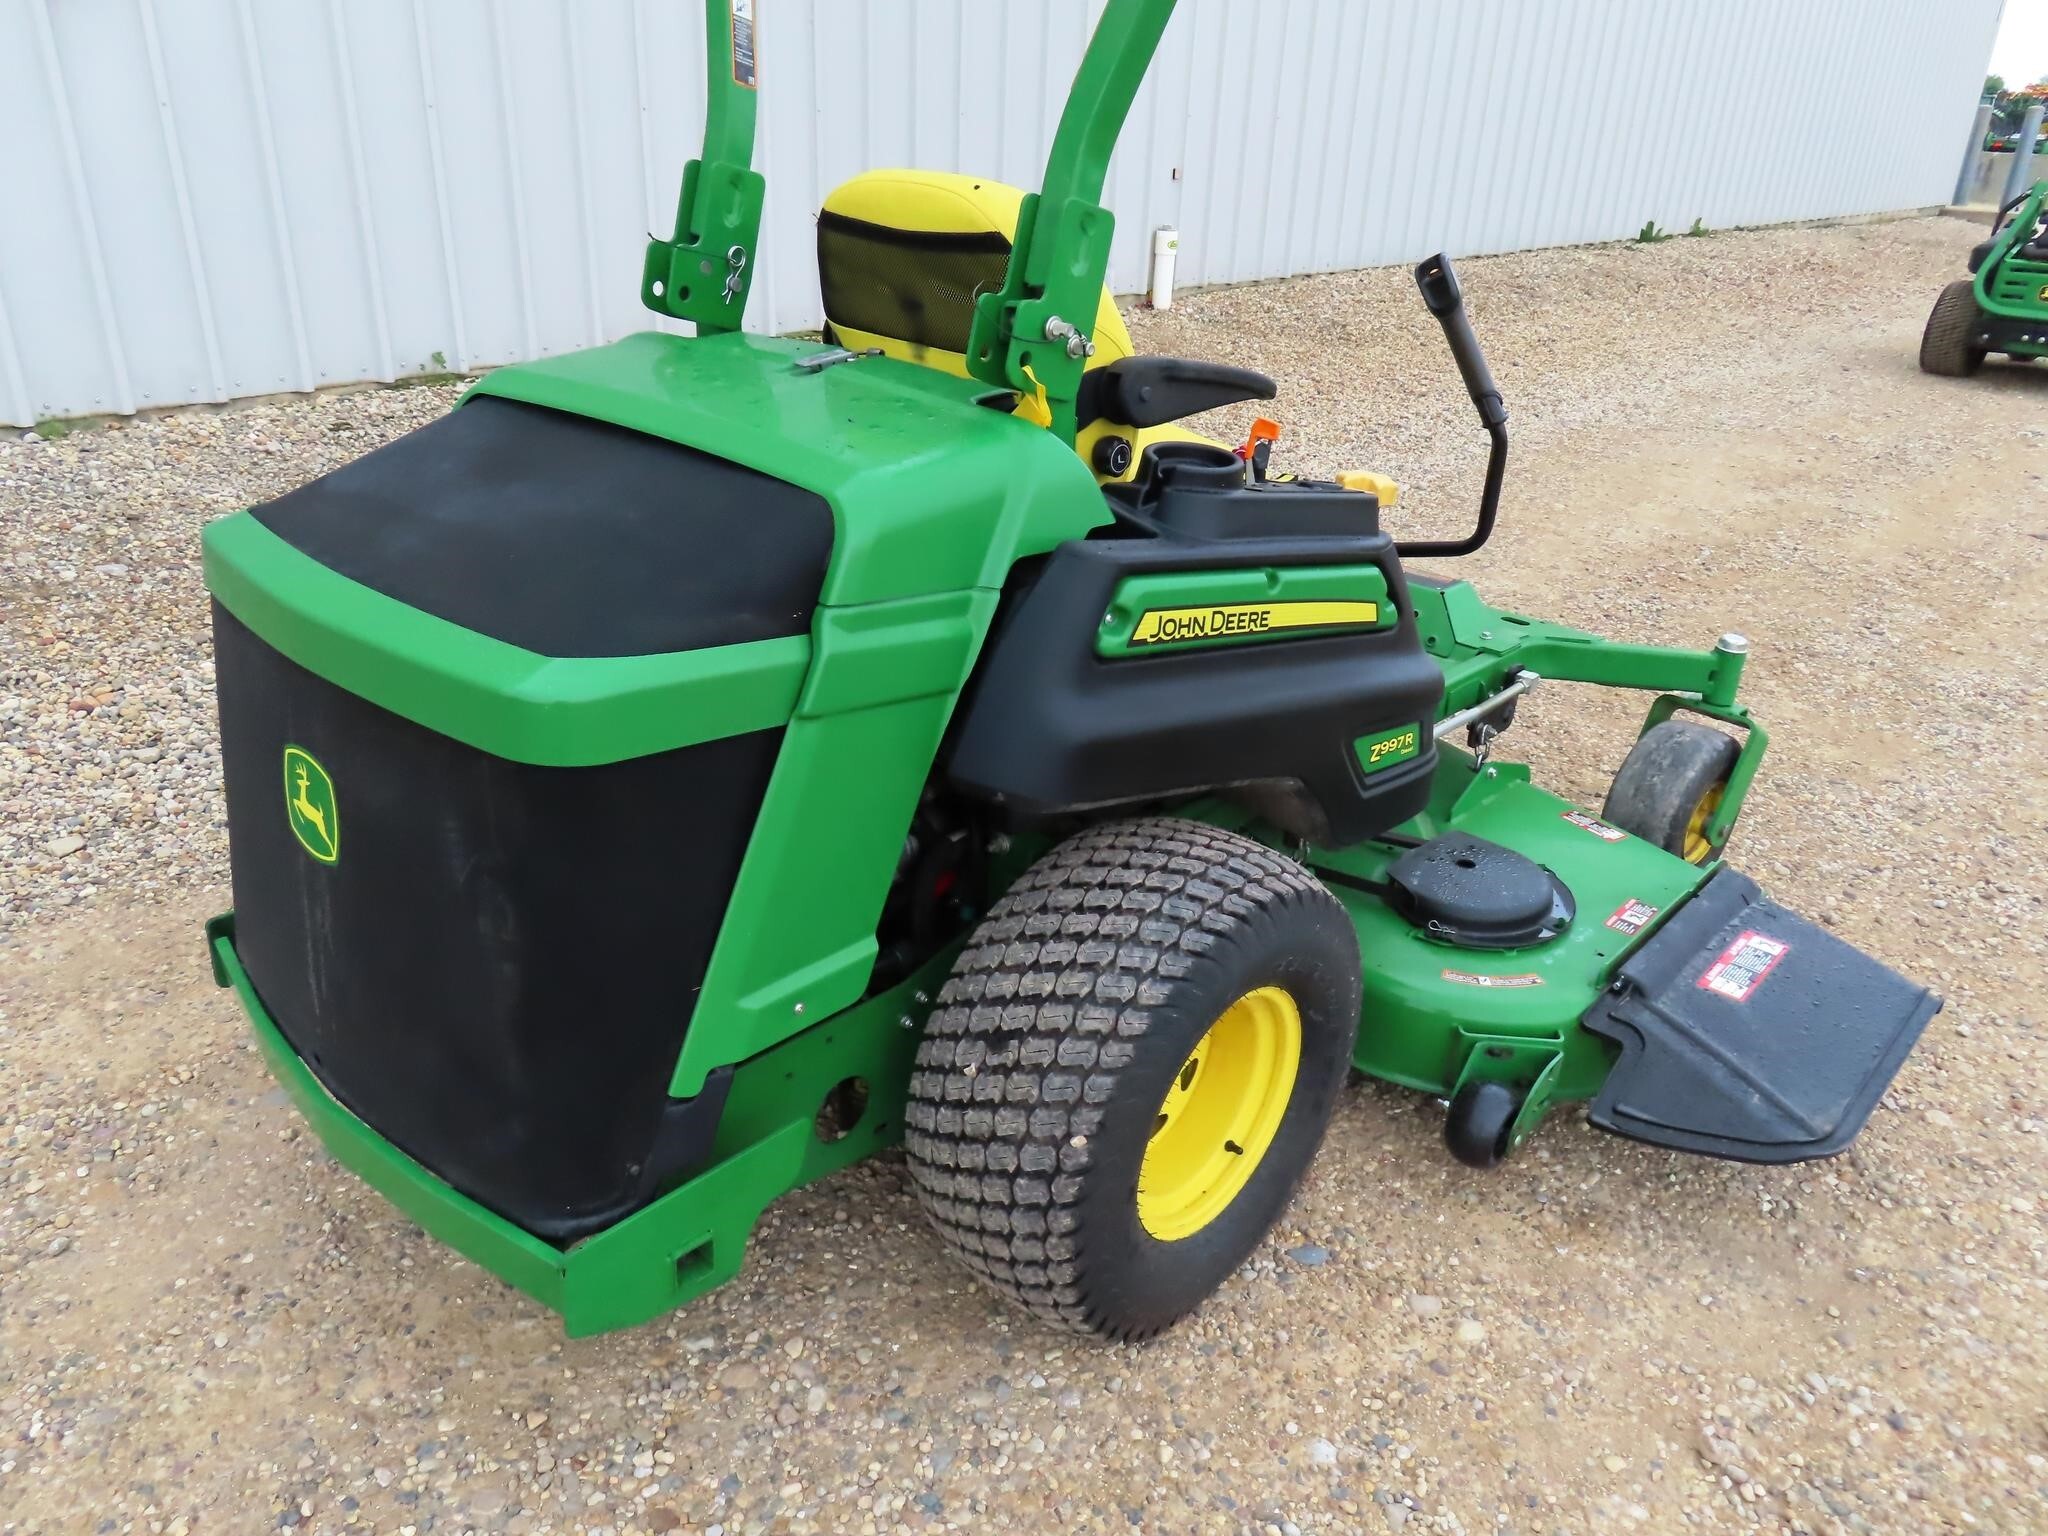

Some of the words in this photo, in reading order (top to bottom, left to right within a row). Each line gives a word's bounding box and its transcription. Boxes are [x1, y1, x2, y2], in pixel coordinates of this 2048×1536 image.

[1149, 613, 1206, 640] JOHN
[1210, 610, 1271, 633] DEERE
[1369, 732, 1414, 763] Z997R
